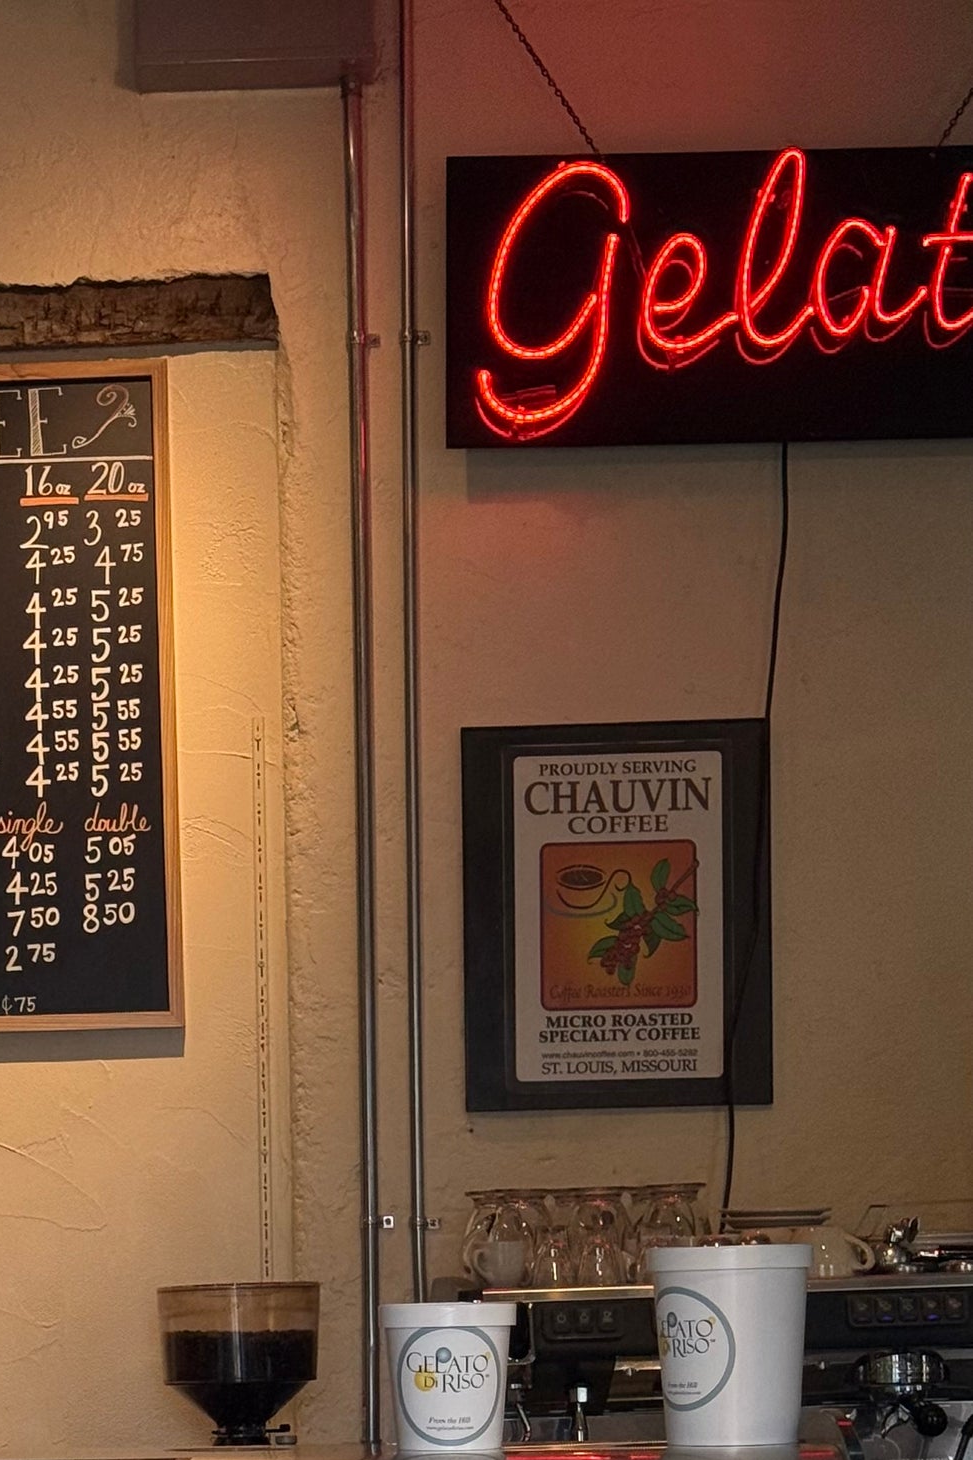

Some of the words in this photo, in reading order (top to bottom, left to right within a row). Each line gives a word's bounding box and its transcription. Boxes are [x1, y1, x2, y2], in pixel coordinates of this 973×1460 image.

[24, 464, 53, 497] 16
[87, 461, 125, 495] 20
[538, 762, 617, 777] PROUDLY
[621, 759, 697, 775] SERVING
[523, 777, 712, 817] CHAUVIN
[84, 802, 152, 833] double
[567, 813, 669, 835] COFFEE
[545, 1014, 607, 1030] MICRO
[612, 1012, 694, 1028] ROASTED
[539, 1028, 631, 1044] SPECIALTY
[635, 1026, 701, 1042] COFFEE
[541, 1062, 562, 1076] ST.
[566, 1060, 618, 1076] LOUIS,
[621, 1058, 698, 1074] MISSOURI
[660, 1317, 714, 1339] ELATO
[406, 1349, 489, 1374] GELATO
